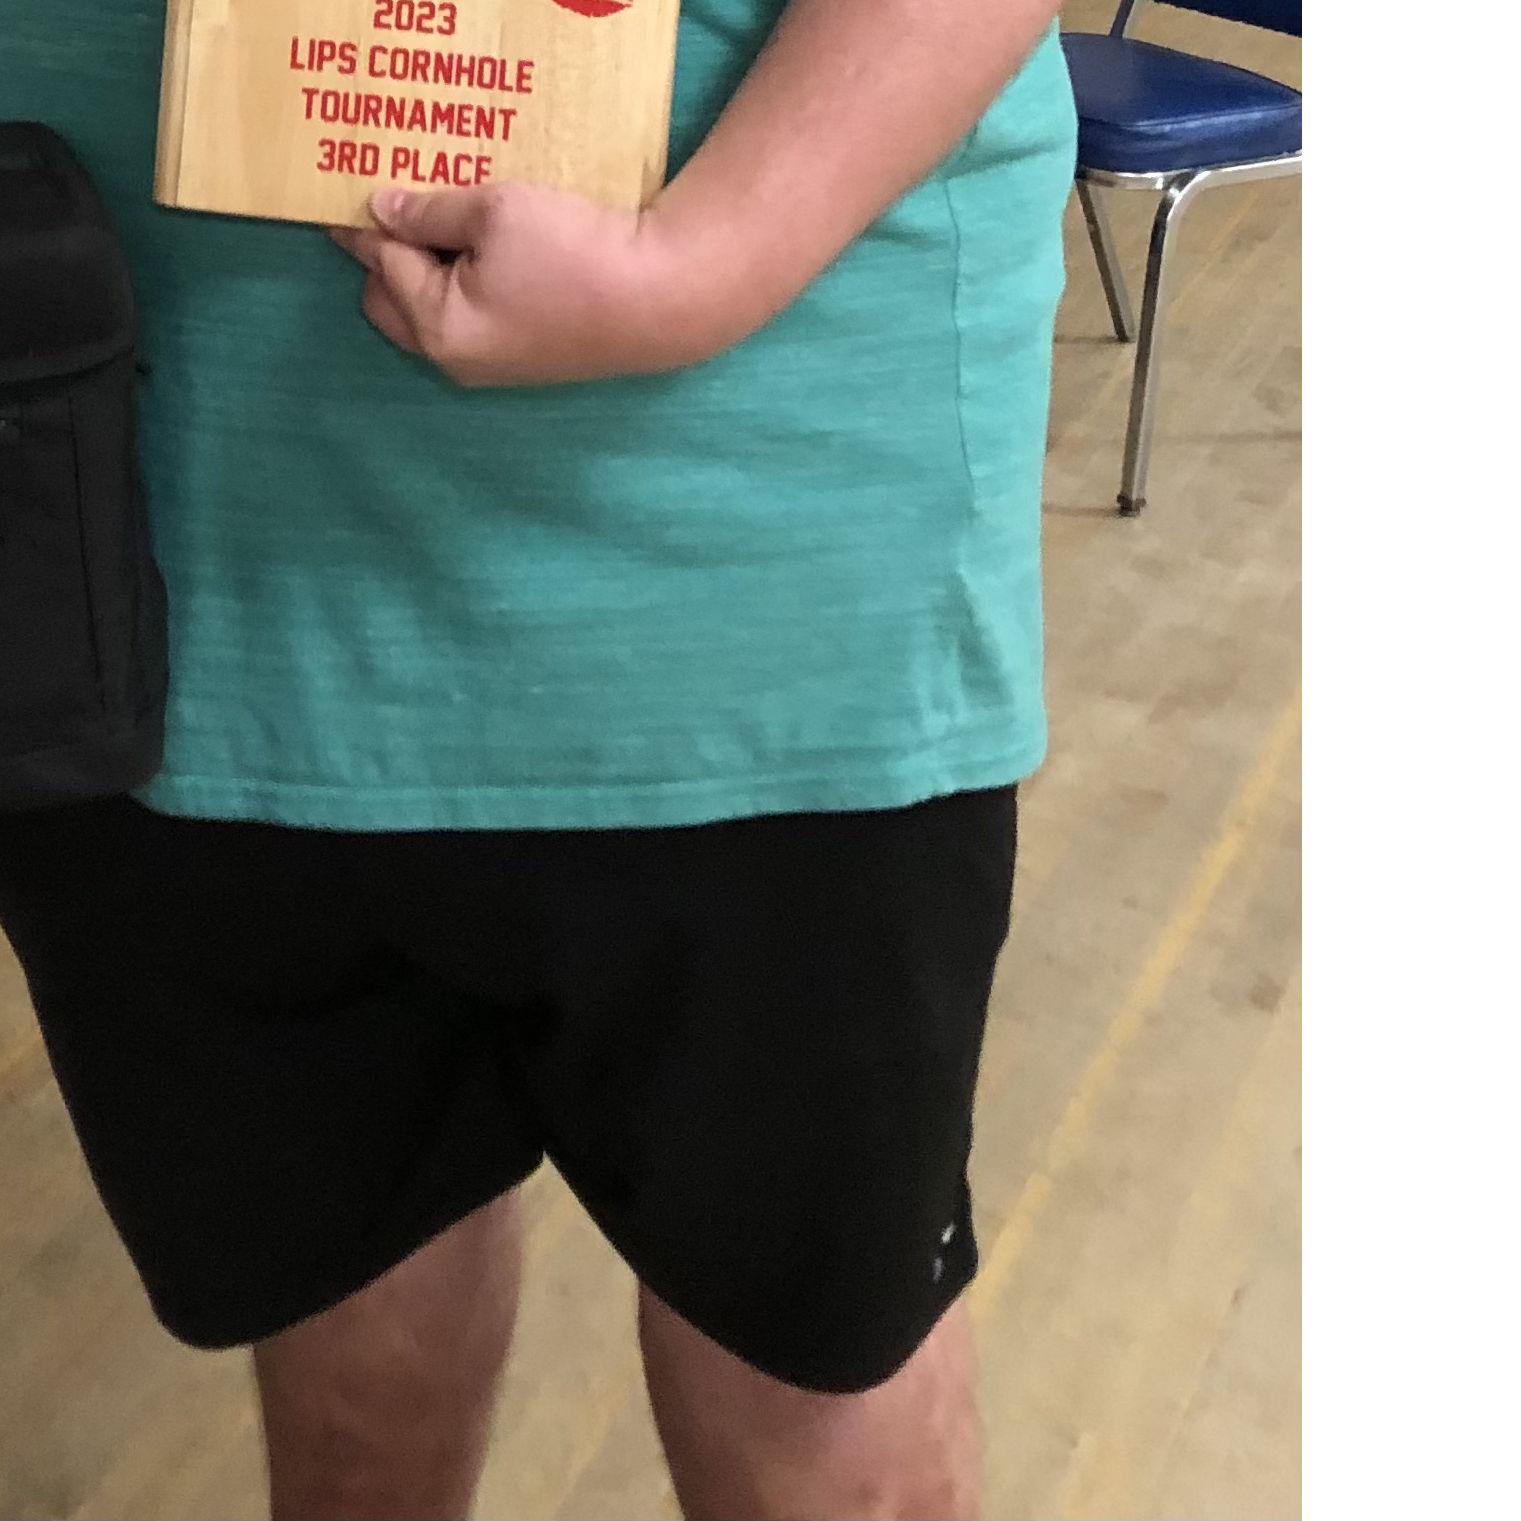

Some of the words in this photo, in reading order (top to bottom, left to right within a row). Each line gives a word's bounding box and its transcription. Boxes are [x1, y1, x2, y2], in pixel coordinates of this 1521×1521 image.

[289, 37, 357, 75] LIPS
[368, 44, 535, 93] CORNHOLE
[302, 87, 517, 141] TOURNAMENT
[316, 139, 380, 177] 3RD
[390, 146, 492, 187] PLACE
